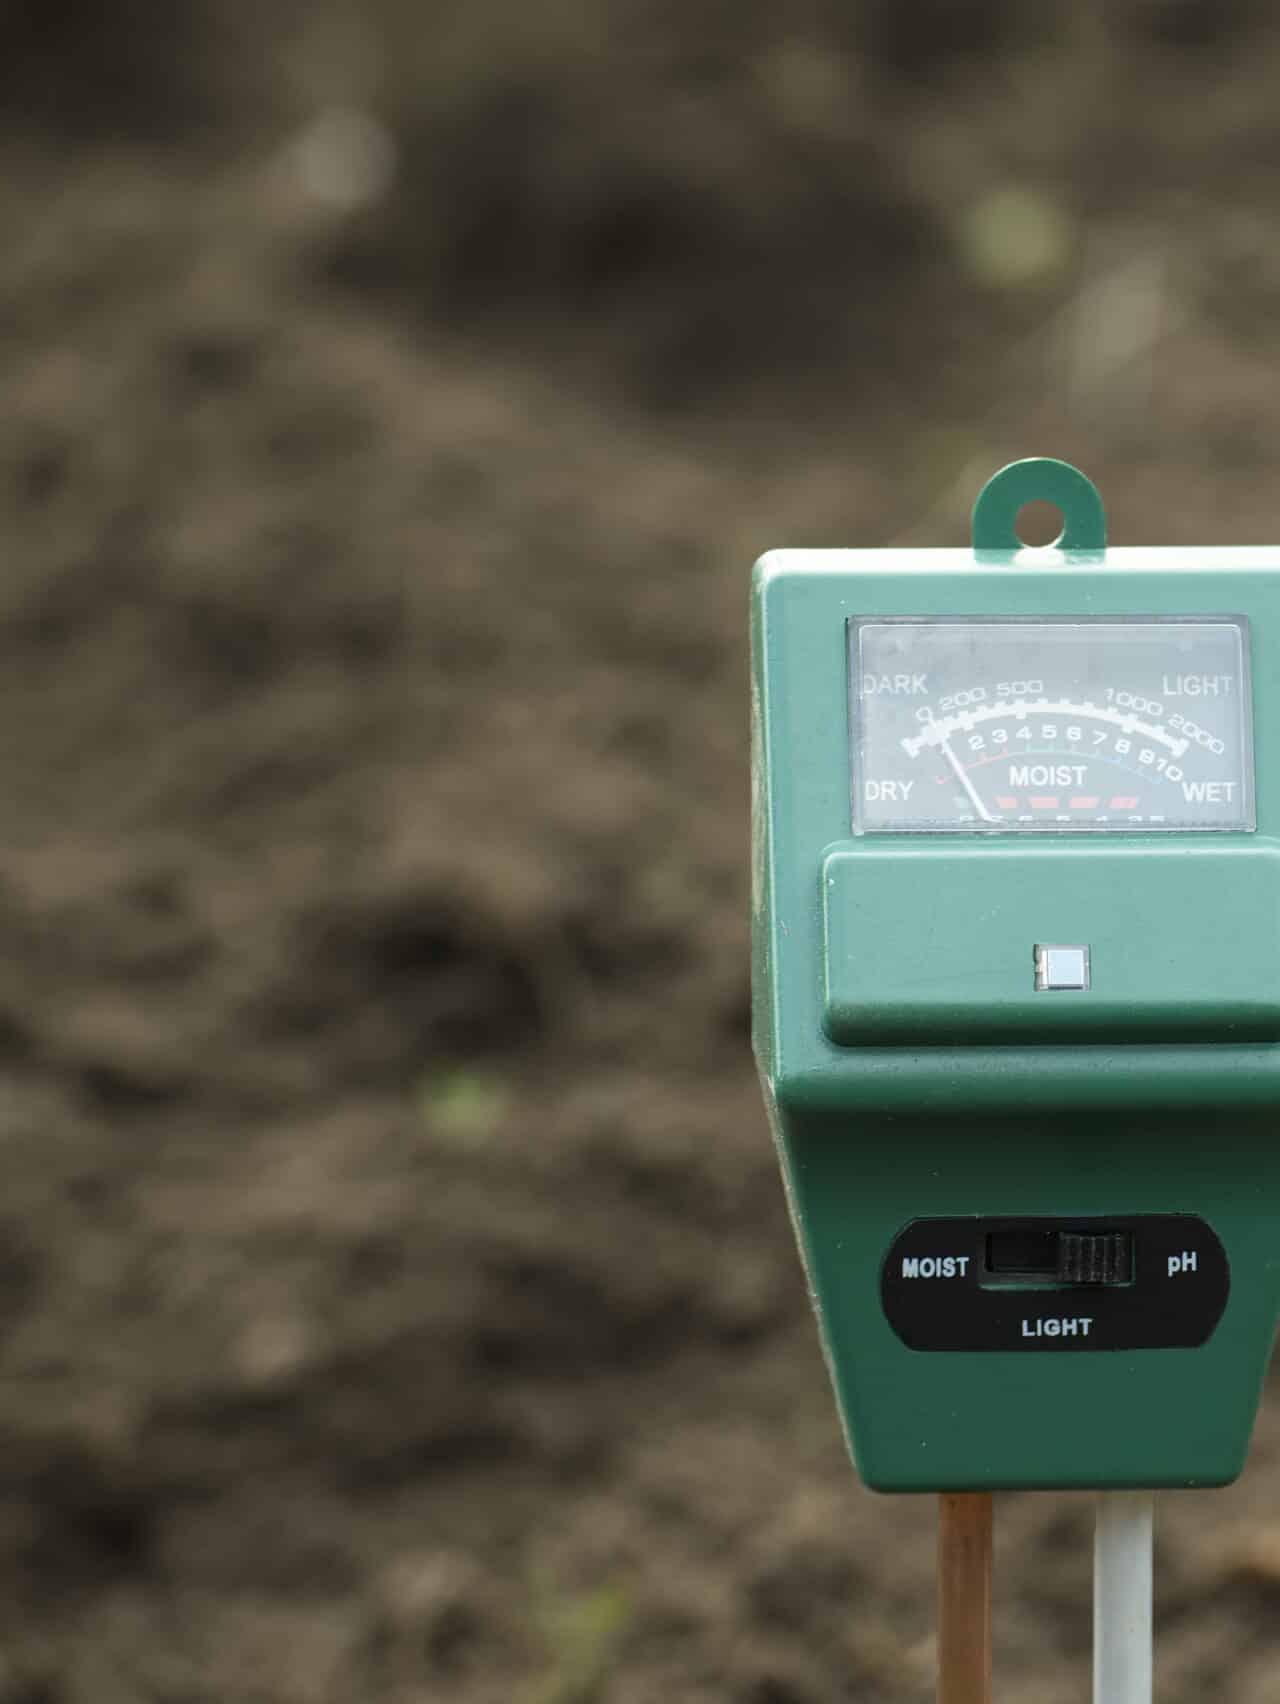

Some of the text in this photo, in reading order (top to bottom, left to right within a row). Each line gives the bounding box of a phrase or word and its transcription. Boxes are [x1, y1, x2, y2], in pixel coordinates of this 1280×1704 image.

[863, 673, 929, 694] DARK
[1162, 673, 1233, 696] LIGHT
[939, 687, 986, 711] 200
[997, 679, 1044, 697] 500
[1103, 687, 1164, 716] 1000
[1168, 713, 1225, 755] 2000
[968, 735, 986, 750] 2
[992, 729, 1008, 743] 3
[1015, 725, 1032, 739] 4
[1042, 724, 1057, 739] 5
[1066, 726, 1082, 740] 6
[1092, 730, 1107, 745] 7
[1114, 738, 1131, 754] 8
[1156, 758, 1184, 782] 10
[1010, 765, 1088, 786] MOIST
[864, 780, 914, 801] DRY
[1182, 781, 1238, 803] WET
[902, 1257, 969, 1278] MOIST
[1168, 1252, 1198, 1277] pH
[1022, 1318, 1093, 1337] LIGHT
